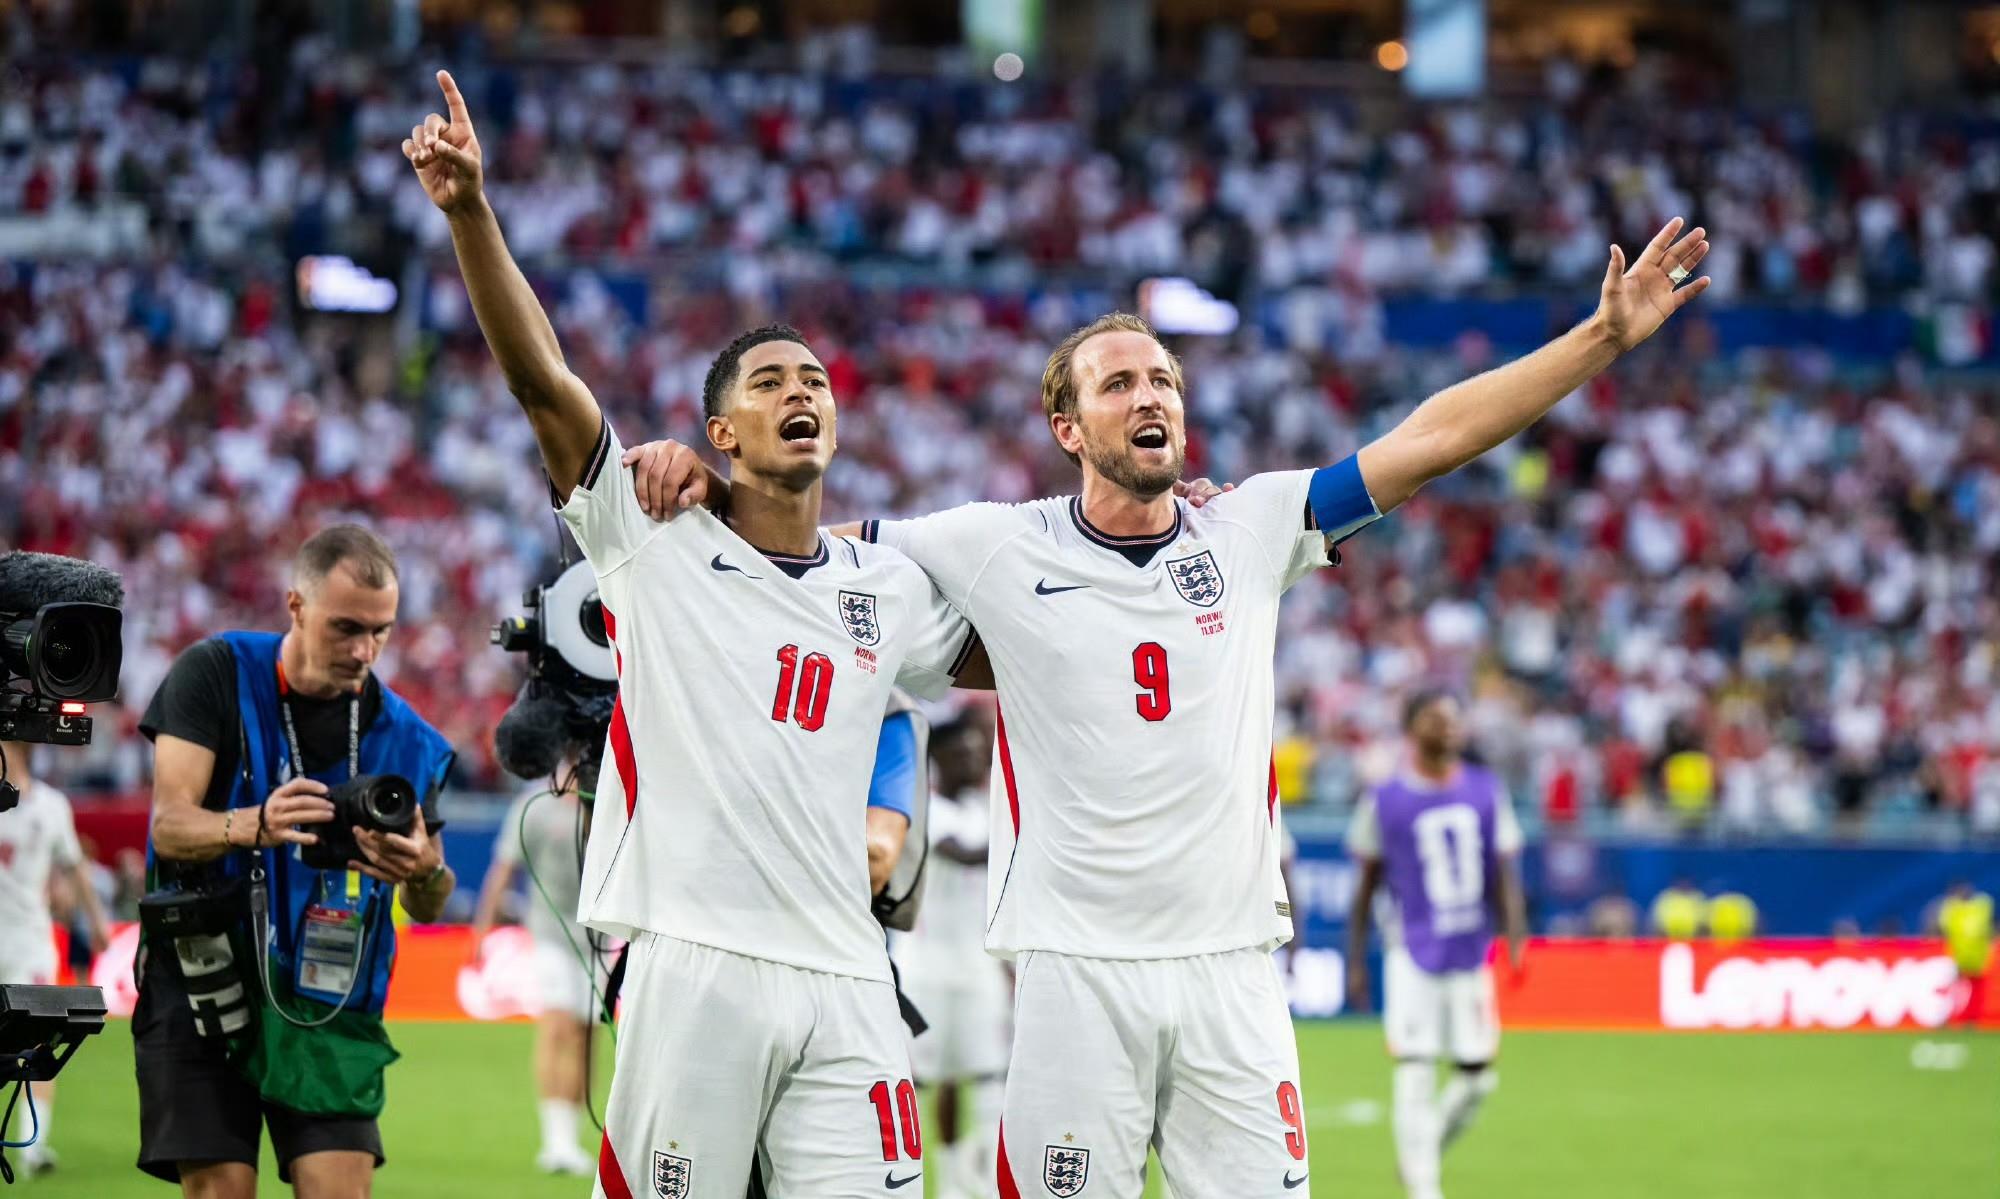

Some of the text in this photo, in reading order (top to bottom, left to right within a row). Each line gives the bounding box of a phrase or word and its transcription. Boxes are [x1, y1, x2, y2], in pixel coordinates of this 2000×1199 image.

[771, 643, 835, 733] 10
[1132, 641, 1172, 721] 9
[868, 1078, 922, 1161] 10
[1276, 1080, 1306, 1160] 9
